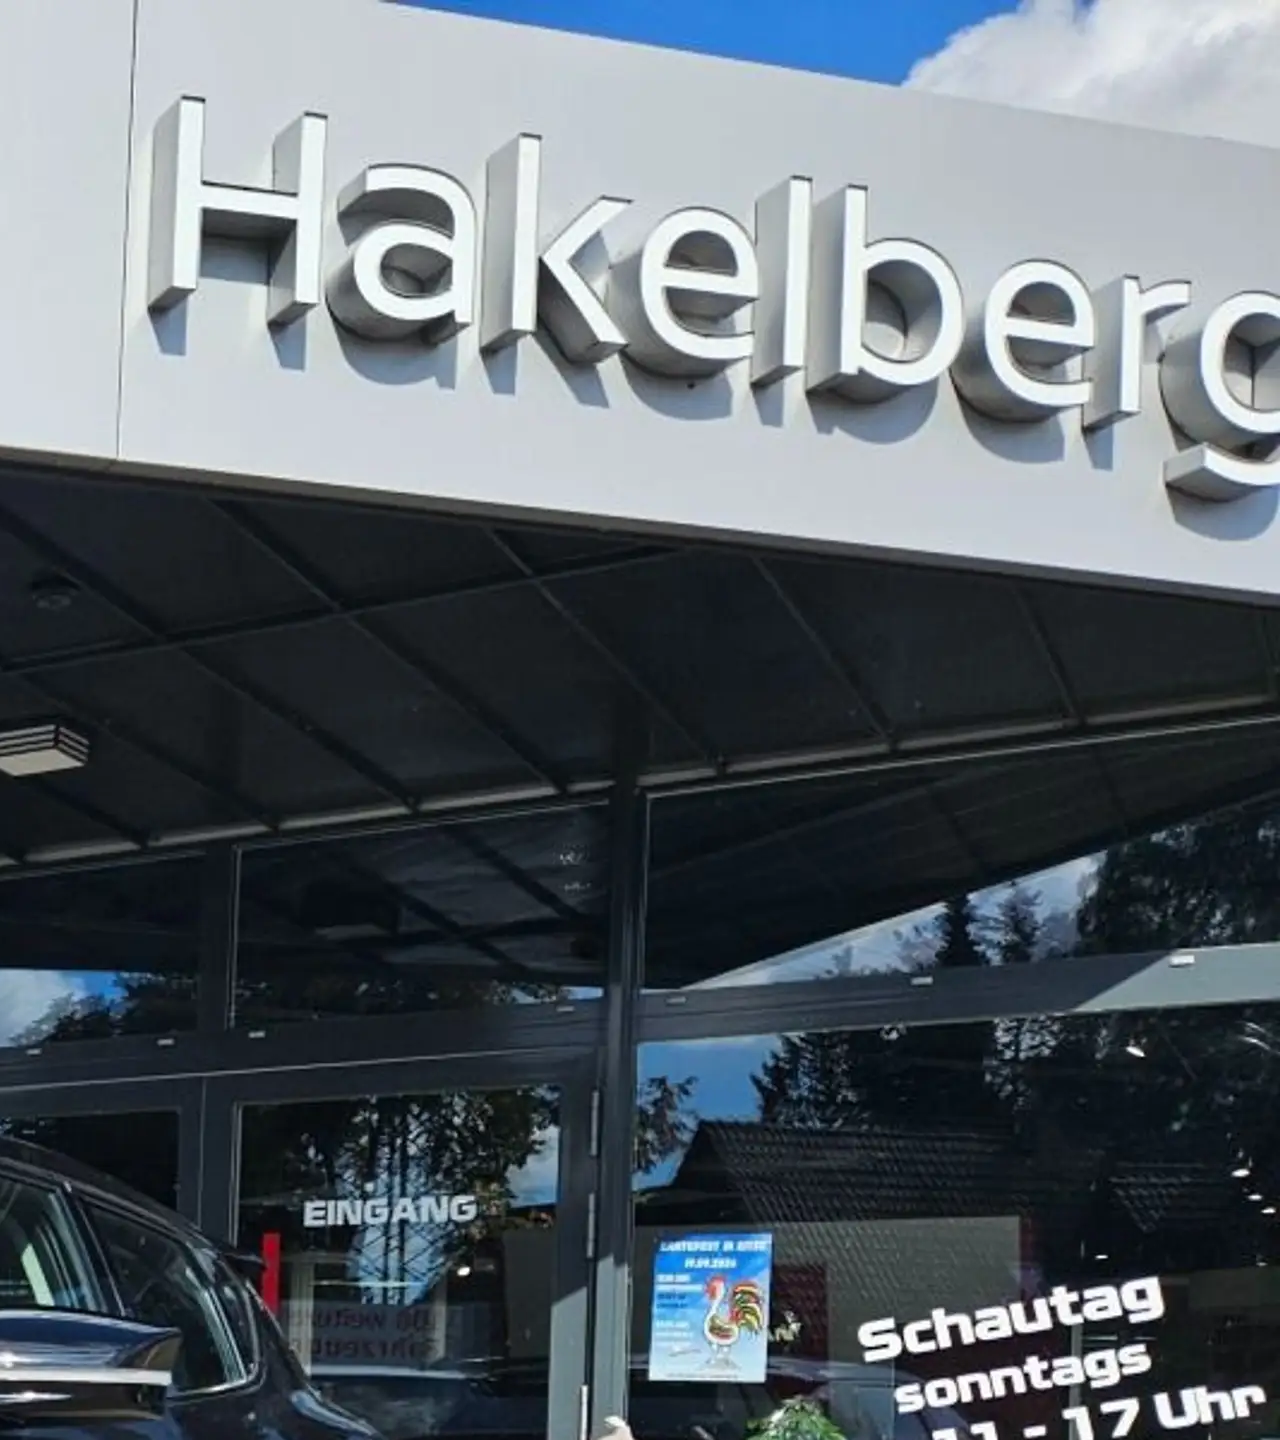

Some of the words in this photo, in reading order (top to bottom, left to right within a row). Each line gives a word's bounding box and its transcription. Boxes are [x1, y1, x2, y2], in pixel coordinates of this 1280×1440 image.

[149, 94, 1280, 502] Hakelberg
[303, 1195, 478, 1227] EINGANG
[857, 1276, 1165, 1362] Schautag
[894, 1342, 1152, 1414] sonntags
[1023, 1423, 1047, 1439] -
[1154, 1384, 1267, 1431] Uhr
